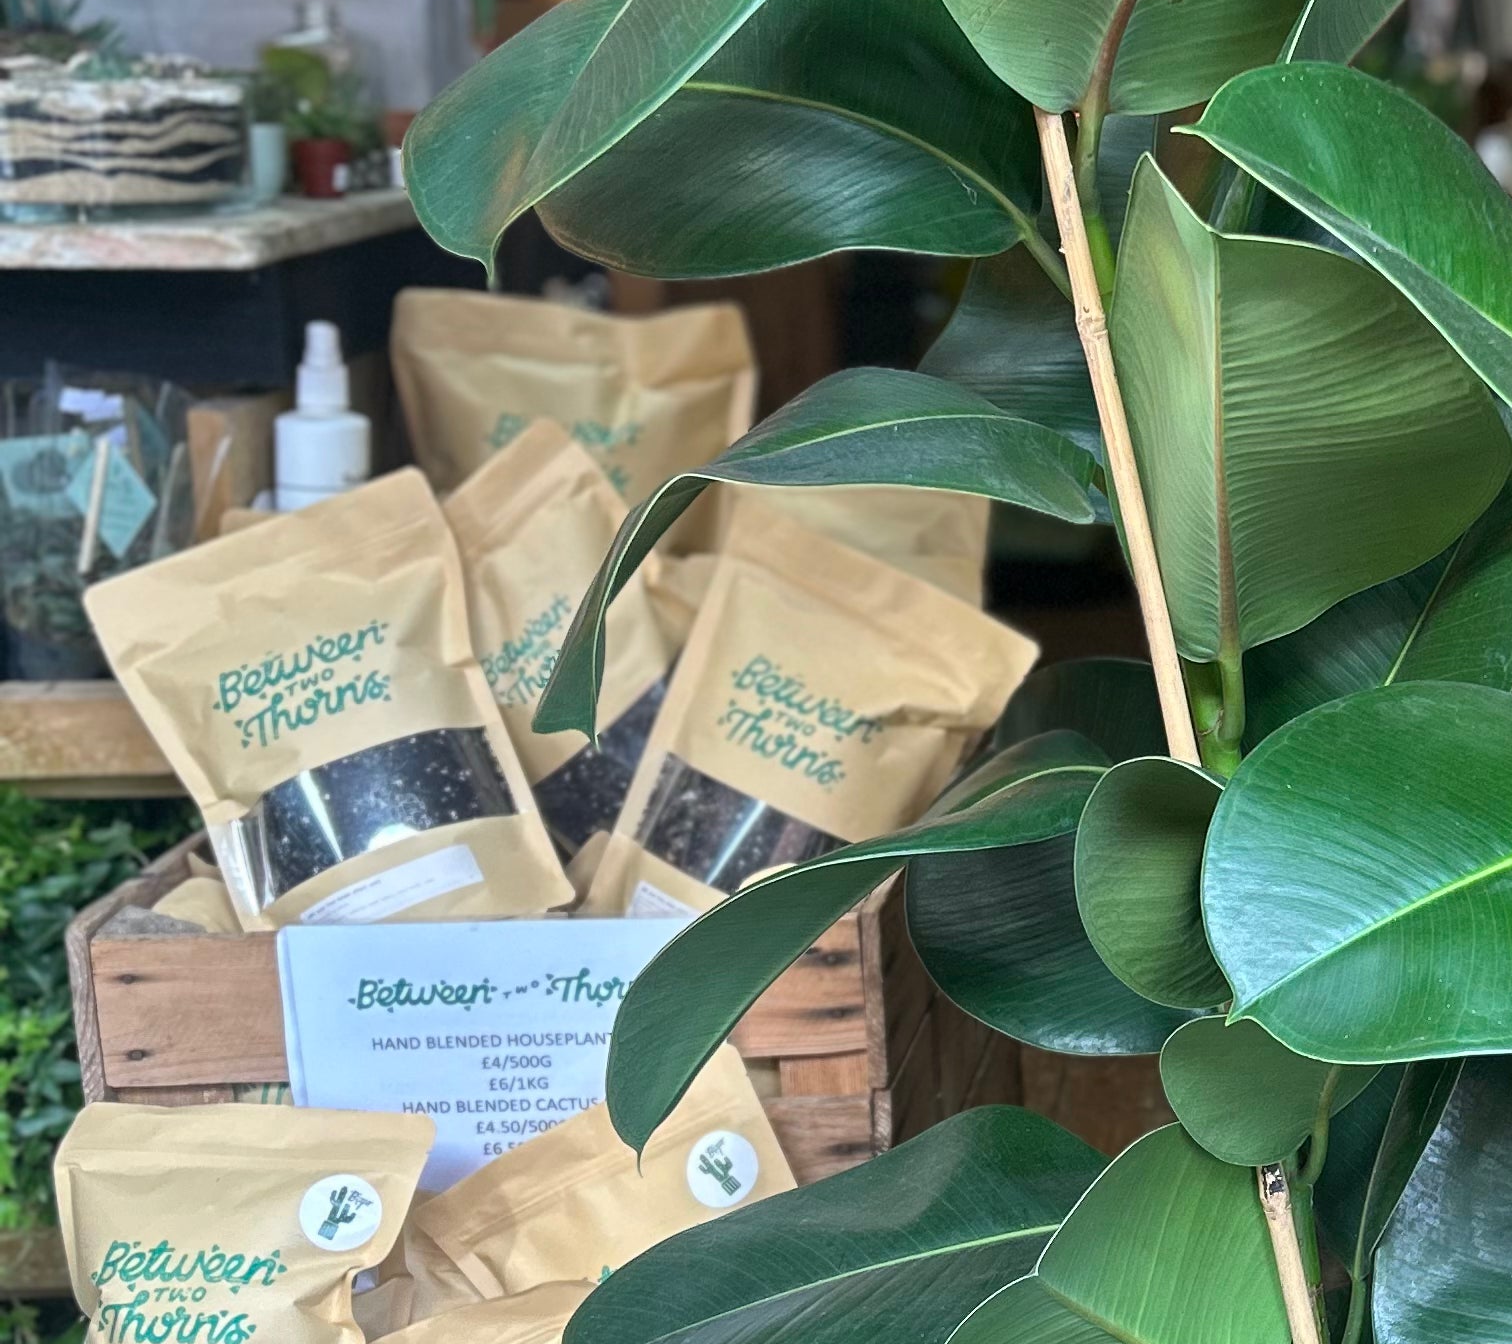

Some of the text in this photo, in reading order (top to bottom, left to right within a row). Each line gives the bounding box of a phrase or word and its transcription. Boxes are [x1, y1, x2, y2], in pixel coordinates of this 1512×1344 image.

[219, 624, 385, 713] Between
[285, 668, 335, 697] TWO
[243, 670, 388, 747] Thorns
[734, 654, 880, 744] Between
[726, 707, 843, 785] Thorns
[356, 978, 492, 1010] Between
[551, 967, 635, 1003] Thor
[372, 1036, 421, 1051] HAND
[426, 1034, 502, 1050] BLENDED
[481, 1055, 552, 1070] £4/500G
[489, 1077, 549, 1092] £6/1KG
[402, 1100, 451, 1115] HAND
[456, 1099, 531, 1114] BLENDED
[476, 1119, 566, 1135] £4.50/500
[96, 1240, 275, 1287] Between
[154, 1286, 206, 1302] TWO
[101, 1290, 251, 1344] Thorns
